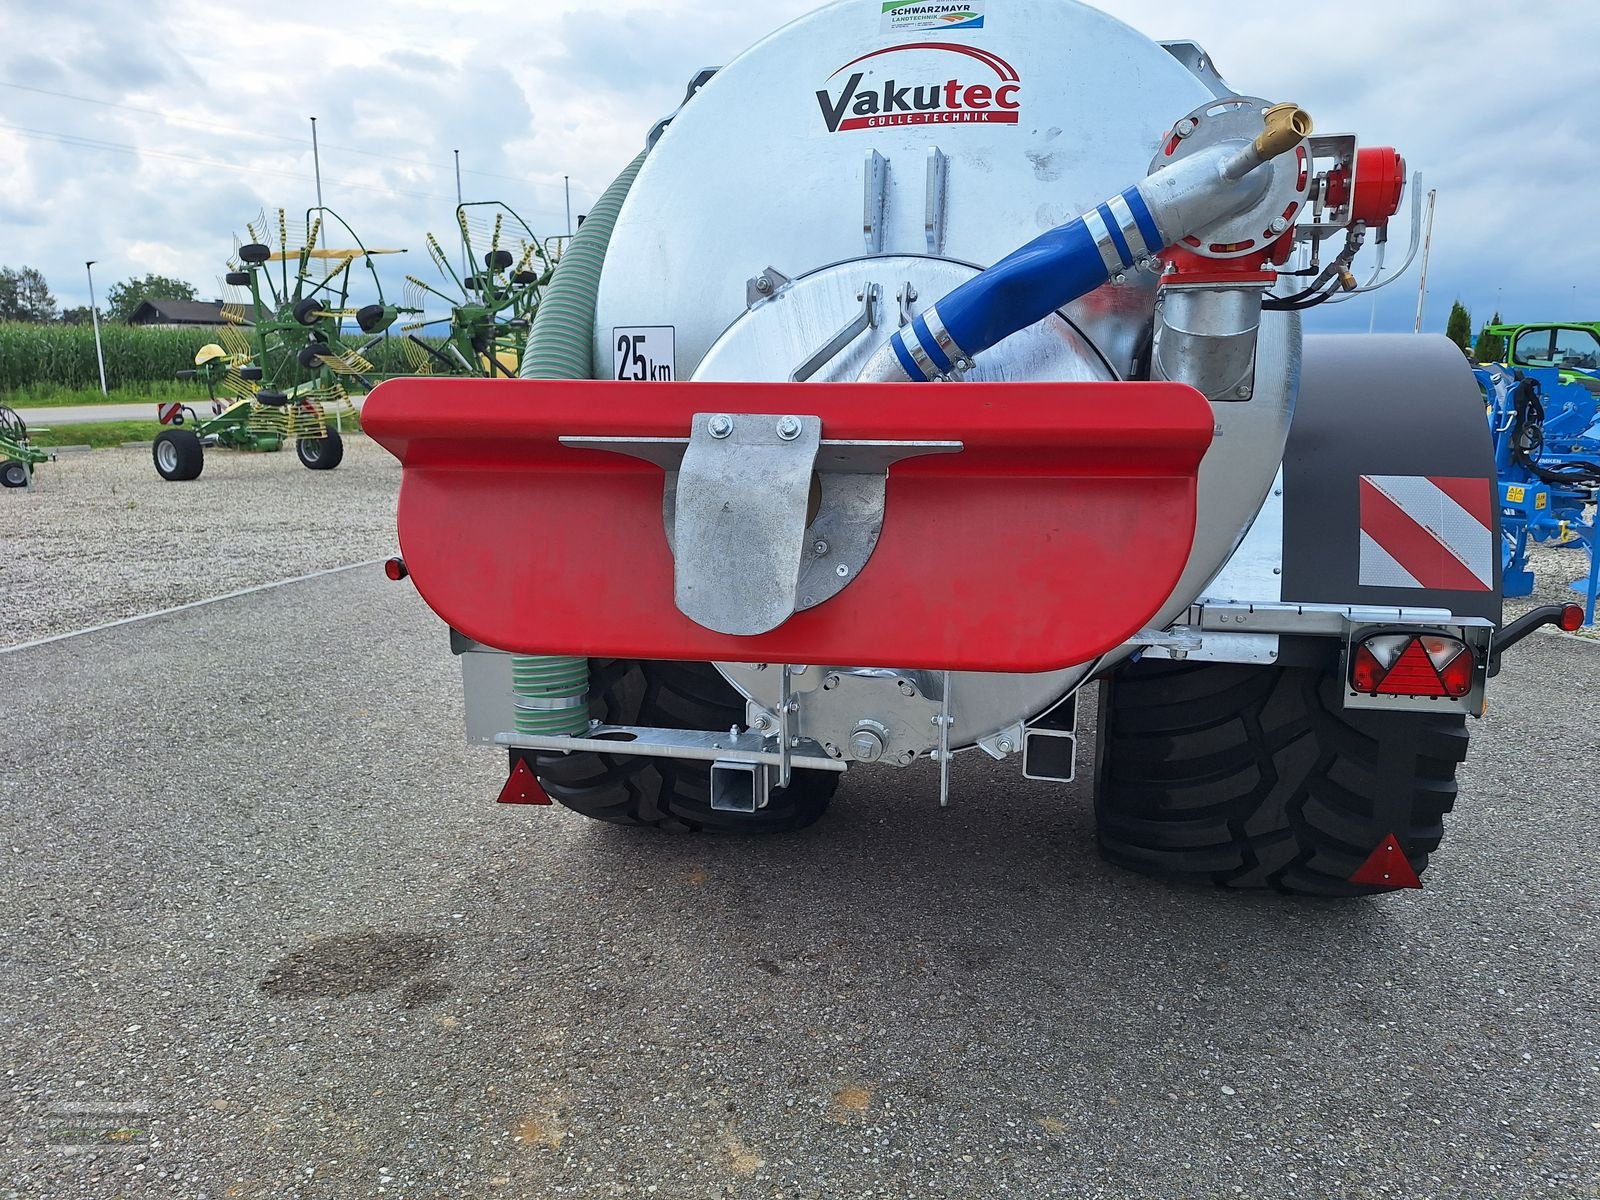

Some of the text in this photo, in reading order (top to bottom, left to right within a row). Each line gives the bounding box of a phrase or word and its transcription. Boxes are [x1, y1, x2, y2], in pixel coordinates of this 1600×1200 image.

[891, 4, 970, 16] SCHWARZMAYR
[892, 14, 938, 22] LANDTECHNIK
[816, 72, 1021, 133] Vakutec
[617, 335, 671, 381] 25 km
